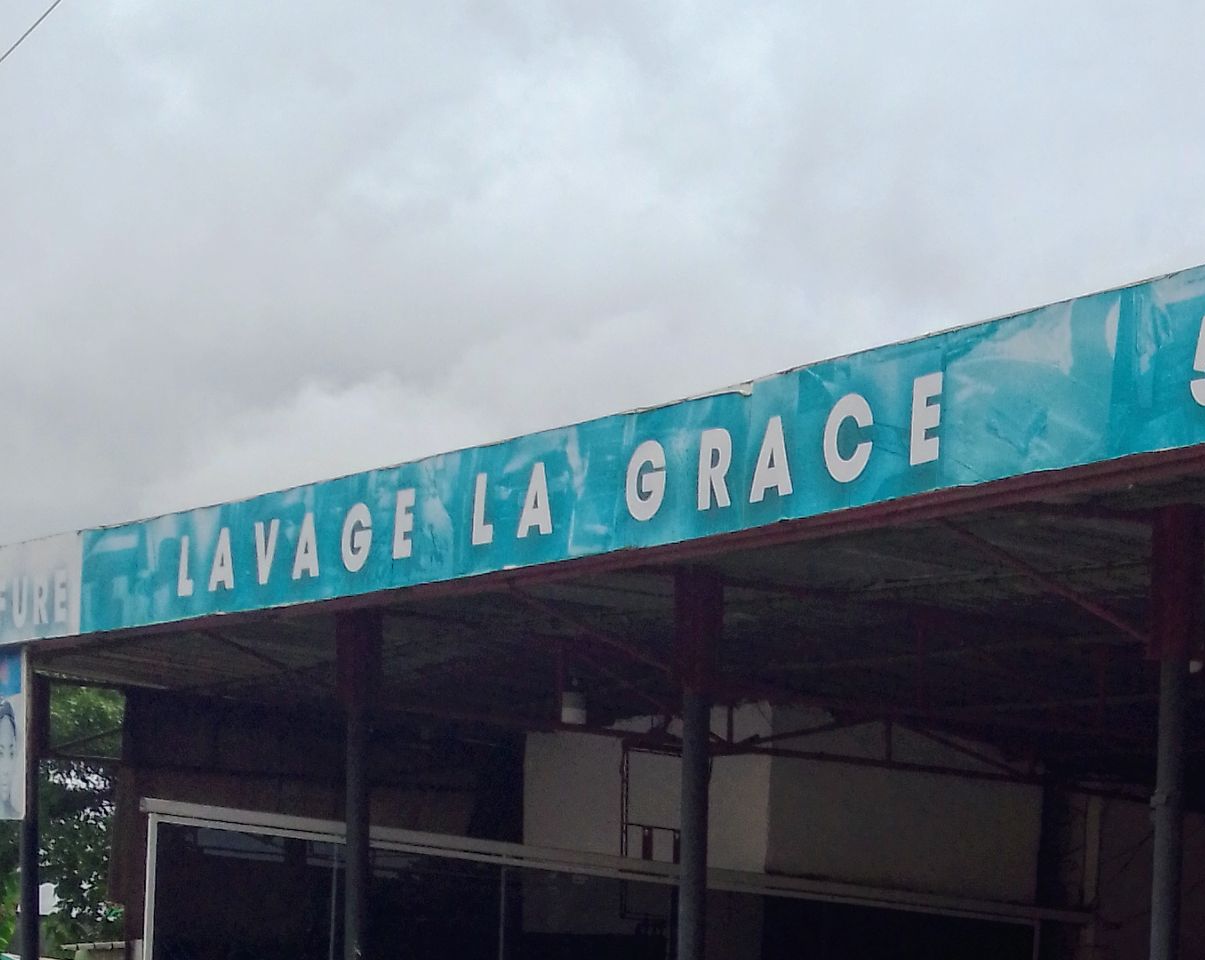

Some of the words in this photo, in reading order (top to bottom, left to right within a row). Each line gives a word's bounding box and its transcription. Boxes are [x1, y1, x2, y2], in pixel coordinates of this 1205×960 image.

[178, 489, 415, 596] LAVAGE
[472, 462, 552, 545] LA
[626, 372, 943, 521] GRACE
